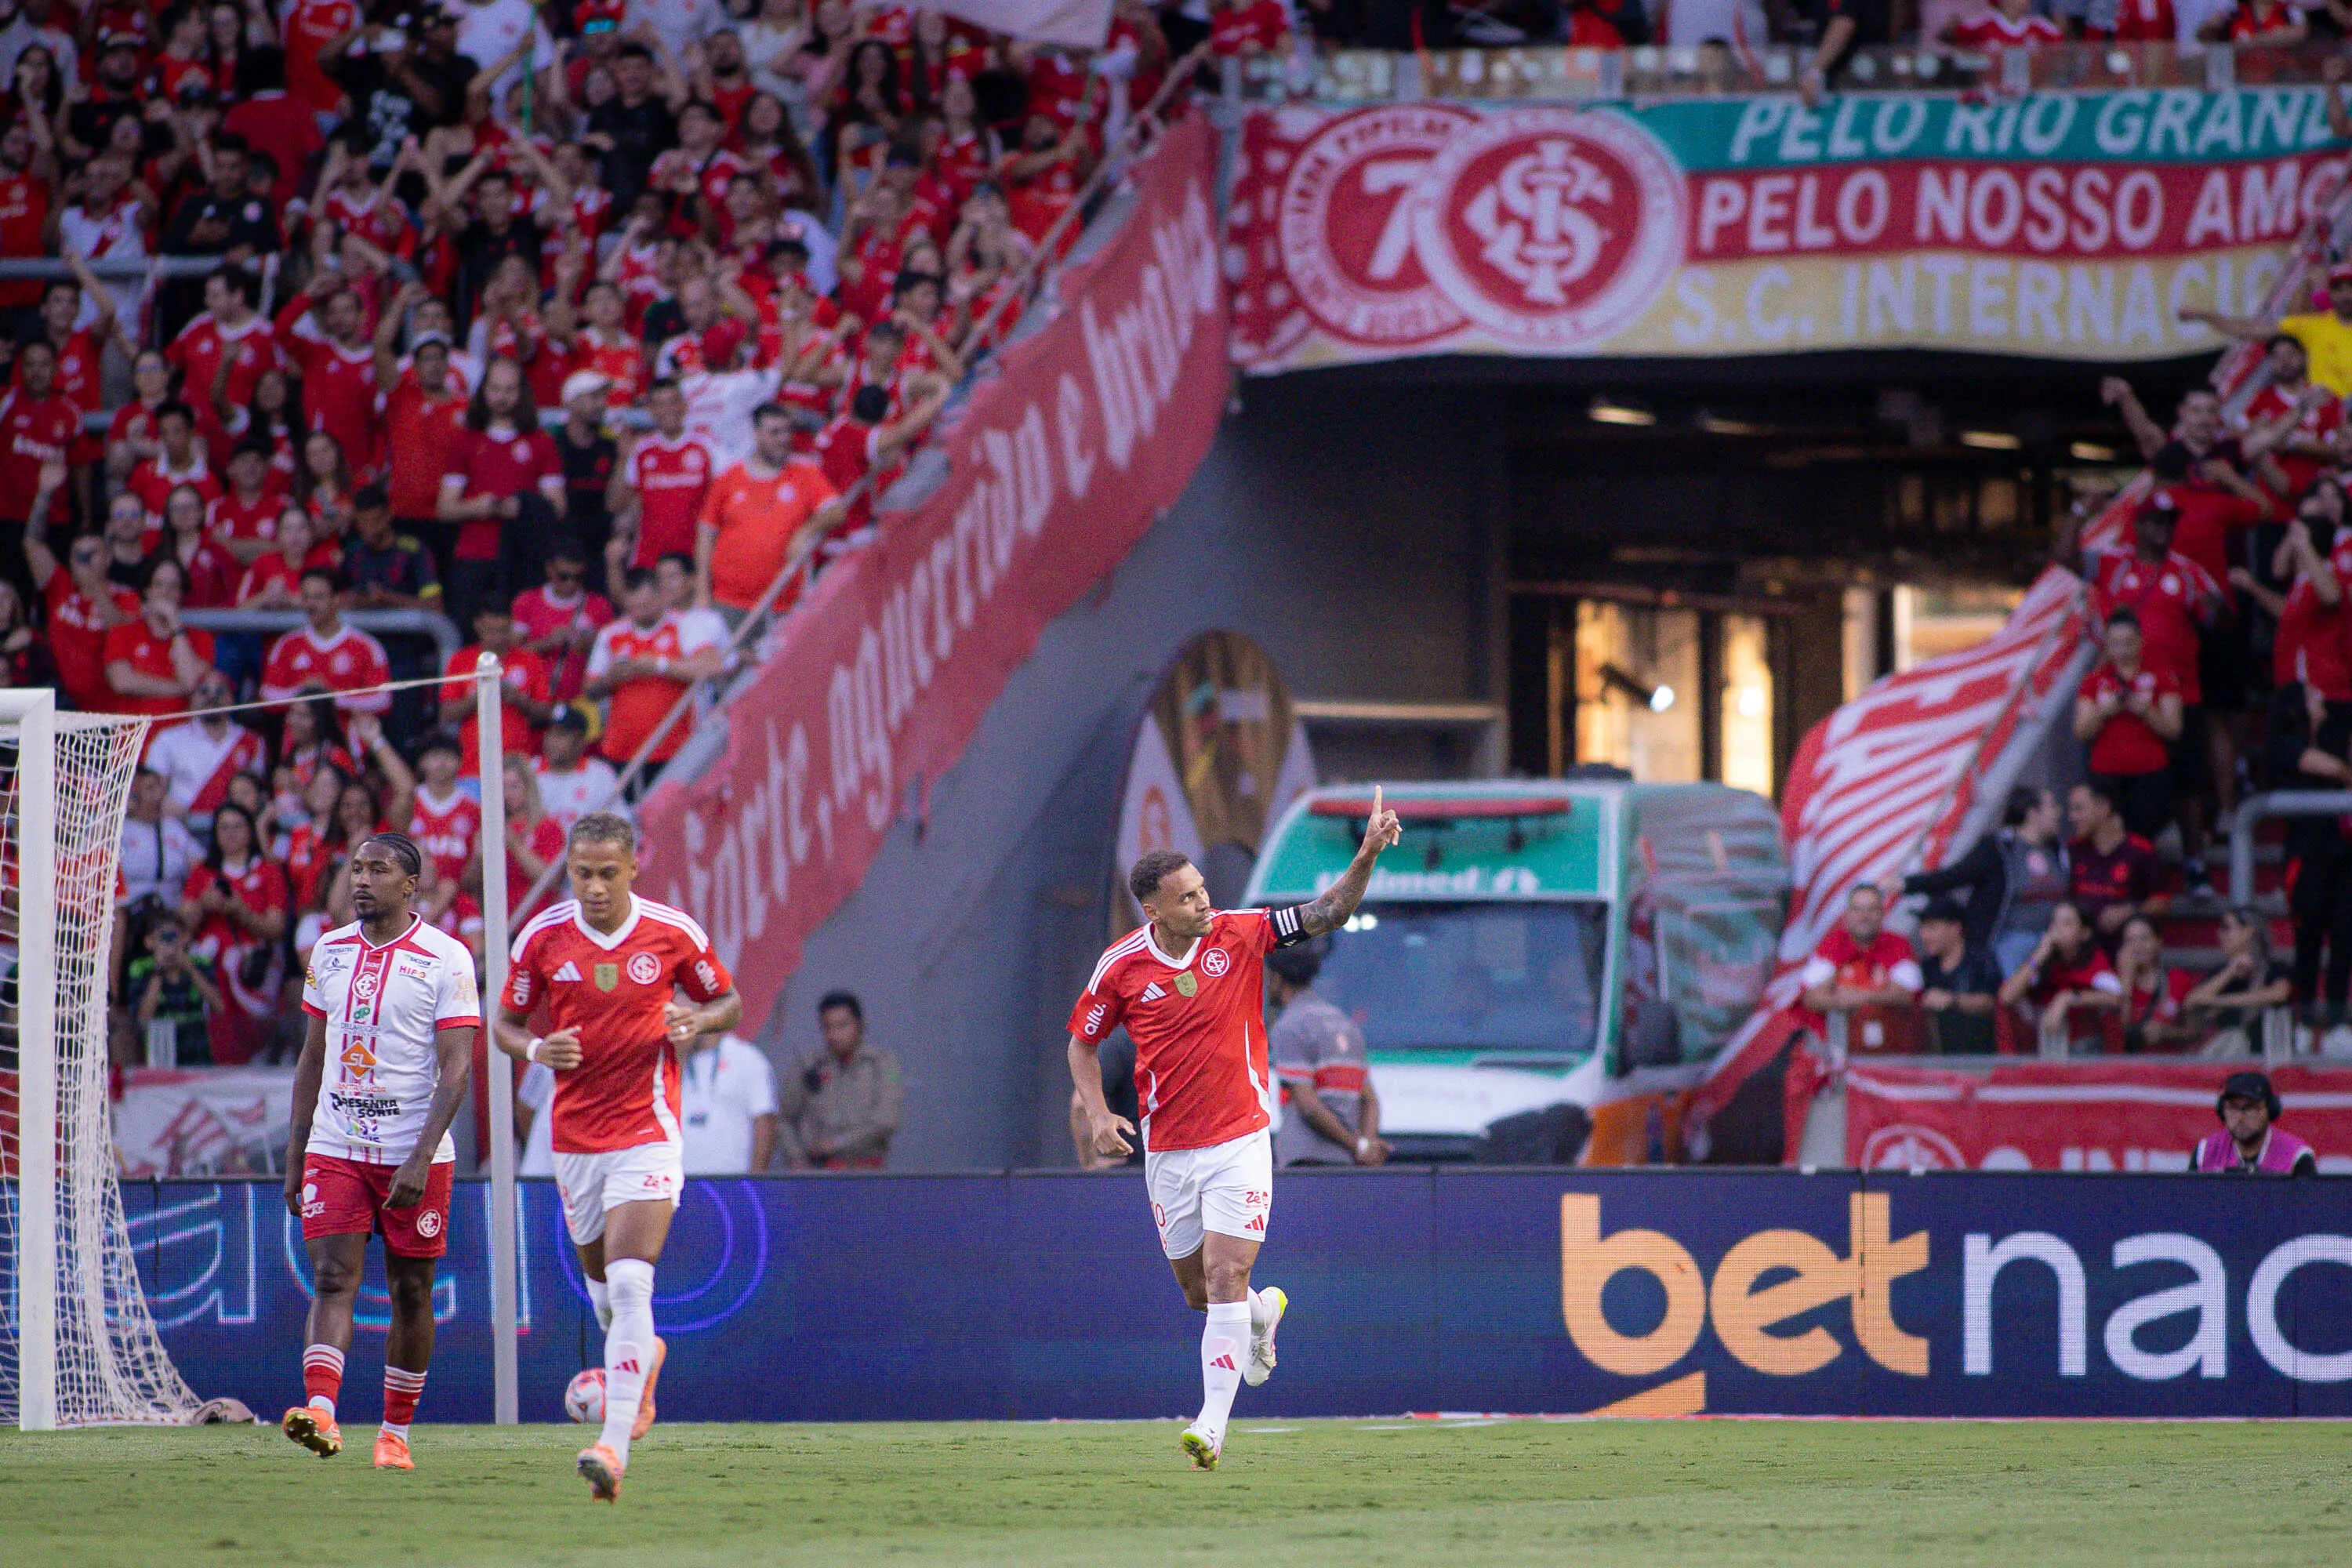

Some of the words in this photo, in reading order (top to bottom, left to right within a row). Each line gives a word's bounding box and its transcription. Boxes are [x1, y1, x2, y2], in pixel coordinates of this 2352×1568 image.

[1730, 94, 1928, 162] PELO
[1946, 90, 2078, 154] RIO
[1700, 169, 1889, 252] PELO
[1916, 167, 2164, 252] NOSSO
[1084, 1003, 1108, 1036] allu.
[358, 1107, 401, 1119] SORTE
